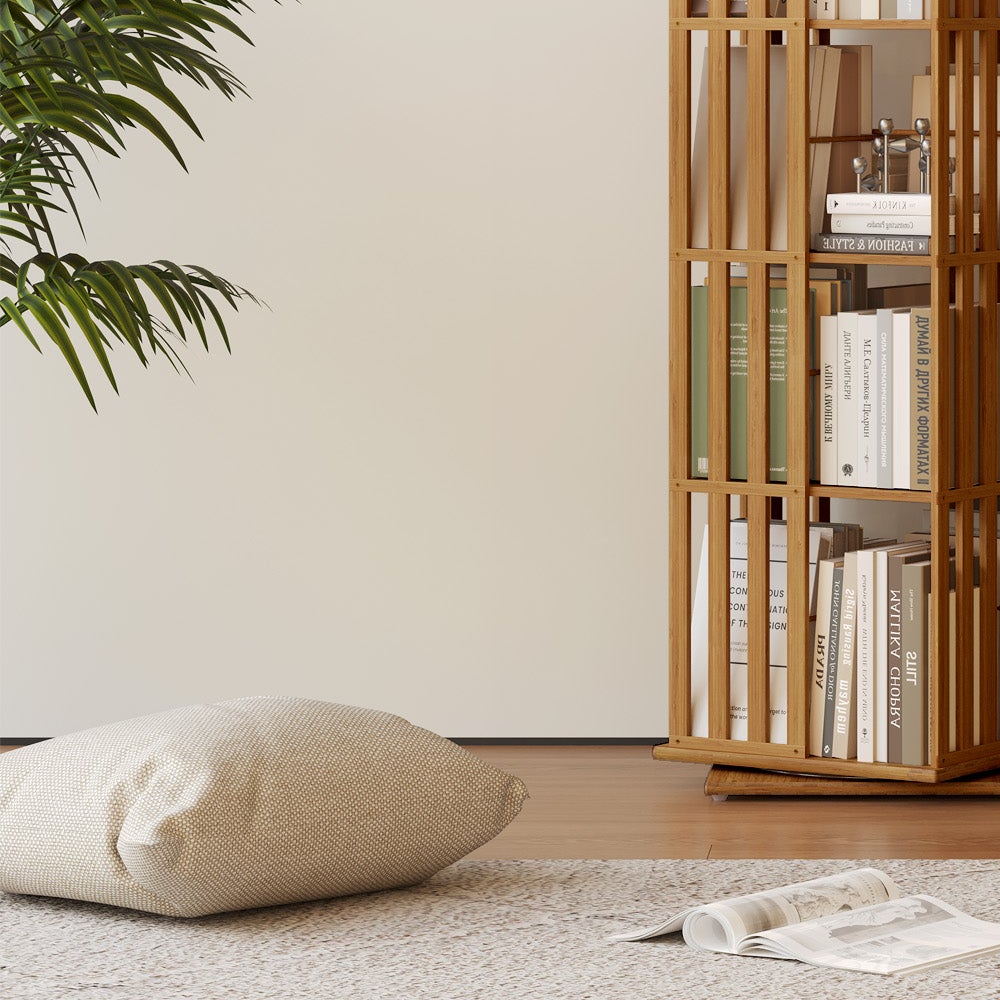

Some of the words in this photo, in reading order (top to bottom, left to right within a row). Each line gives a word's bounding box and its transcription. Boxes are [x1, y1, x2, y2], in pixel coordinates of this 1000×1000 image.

[843, 330, 852, 358] ДАНТЕ
[915, 315, 931, 355] ДУМАЙ
[824, 363, 833, 390] МИРУ
[844, 358, 852, 400] АЛИГЬЕРИ
[917, 358, 929, 366] В
[861, 358, 872, 438] Салтыков-Щедрин
[915, 369, 929, 412] ДРУГИХ
[824, 393, 833, 435] ВЕЧНОМУ
[916, 416, 930, 475] ФОРМАТАХ
[731, 570, 747, 580] THE
